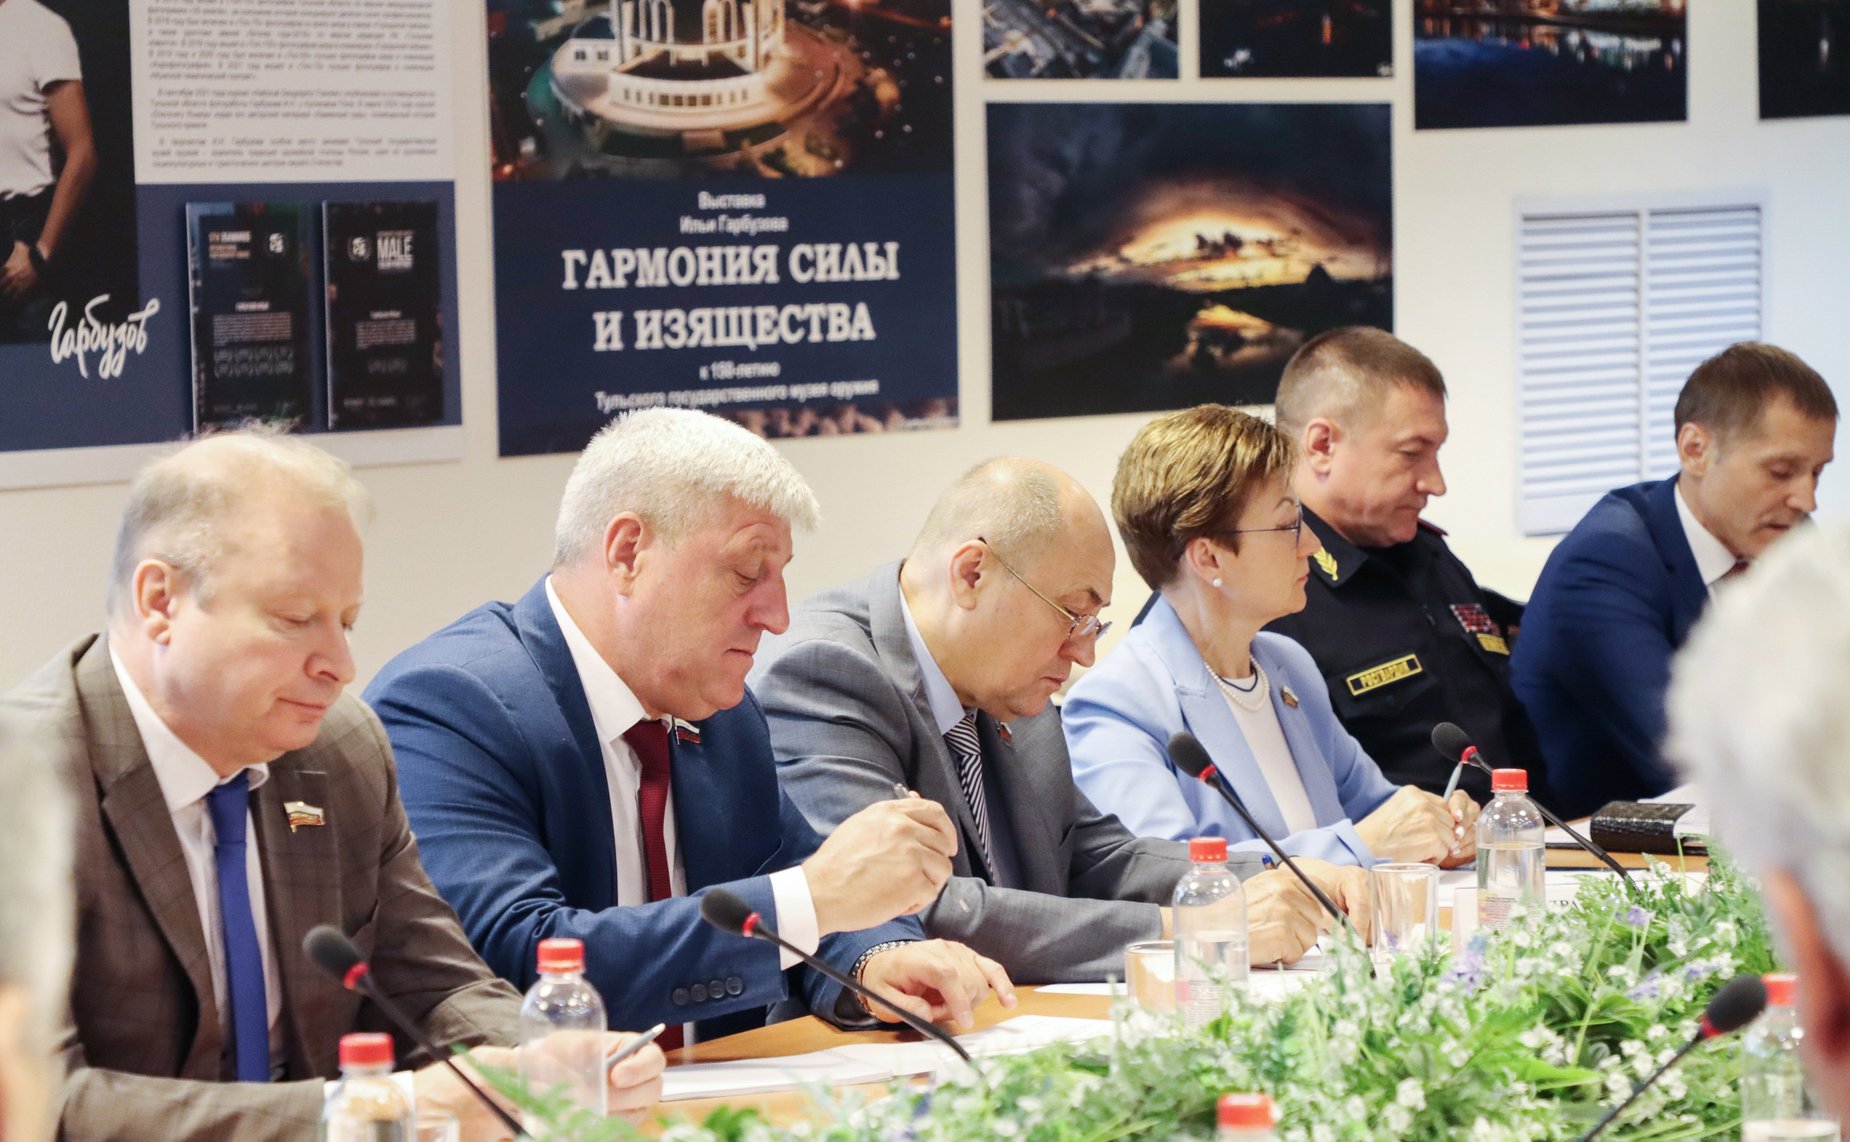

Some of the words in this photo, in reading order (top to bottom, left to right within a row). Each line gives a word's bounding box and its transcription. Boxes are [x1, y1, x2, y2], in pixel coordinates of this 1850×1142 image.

[698, 190, 766, 210] Выставка
[680, 215, 717, 234] Ильи
[718, 214, 789, 237] Гарбузова
[377, 235, 413, 260] MALE
[561, 244, 780, 290] ГАРМОНИЯ
[789, 241, 901, 284] СИЛЫ
[592, 311, 624, 351] И
[634, 302, 877, 351] ИЗЯЩЕСТВА
[594, 391, 666, 414] Тульского
[668, 384, 787, 408] государственного
[788, 382, 828, 403] музея
[829, 379, 880, 400] оружия
